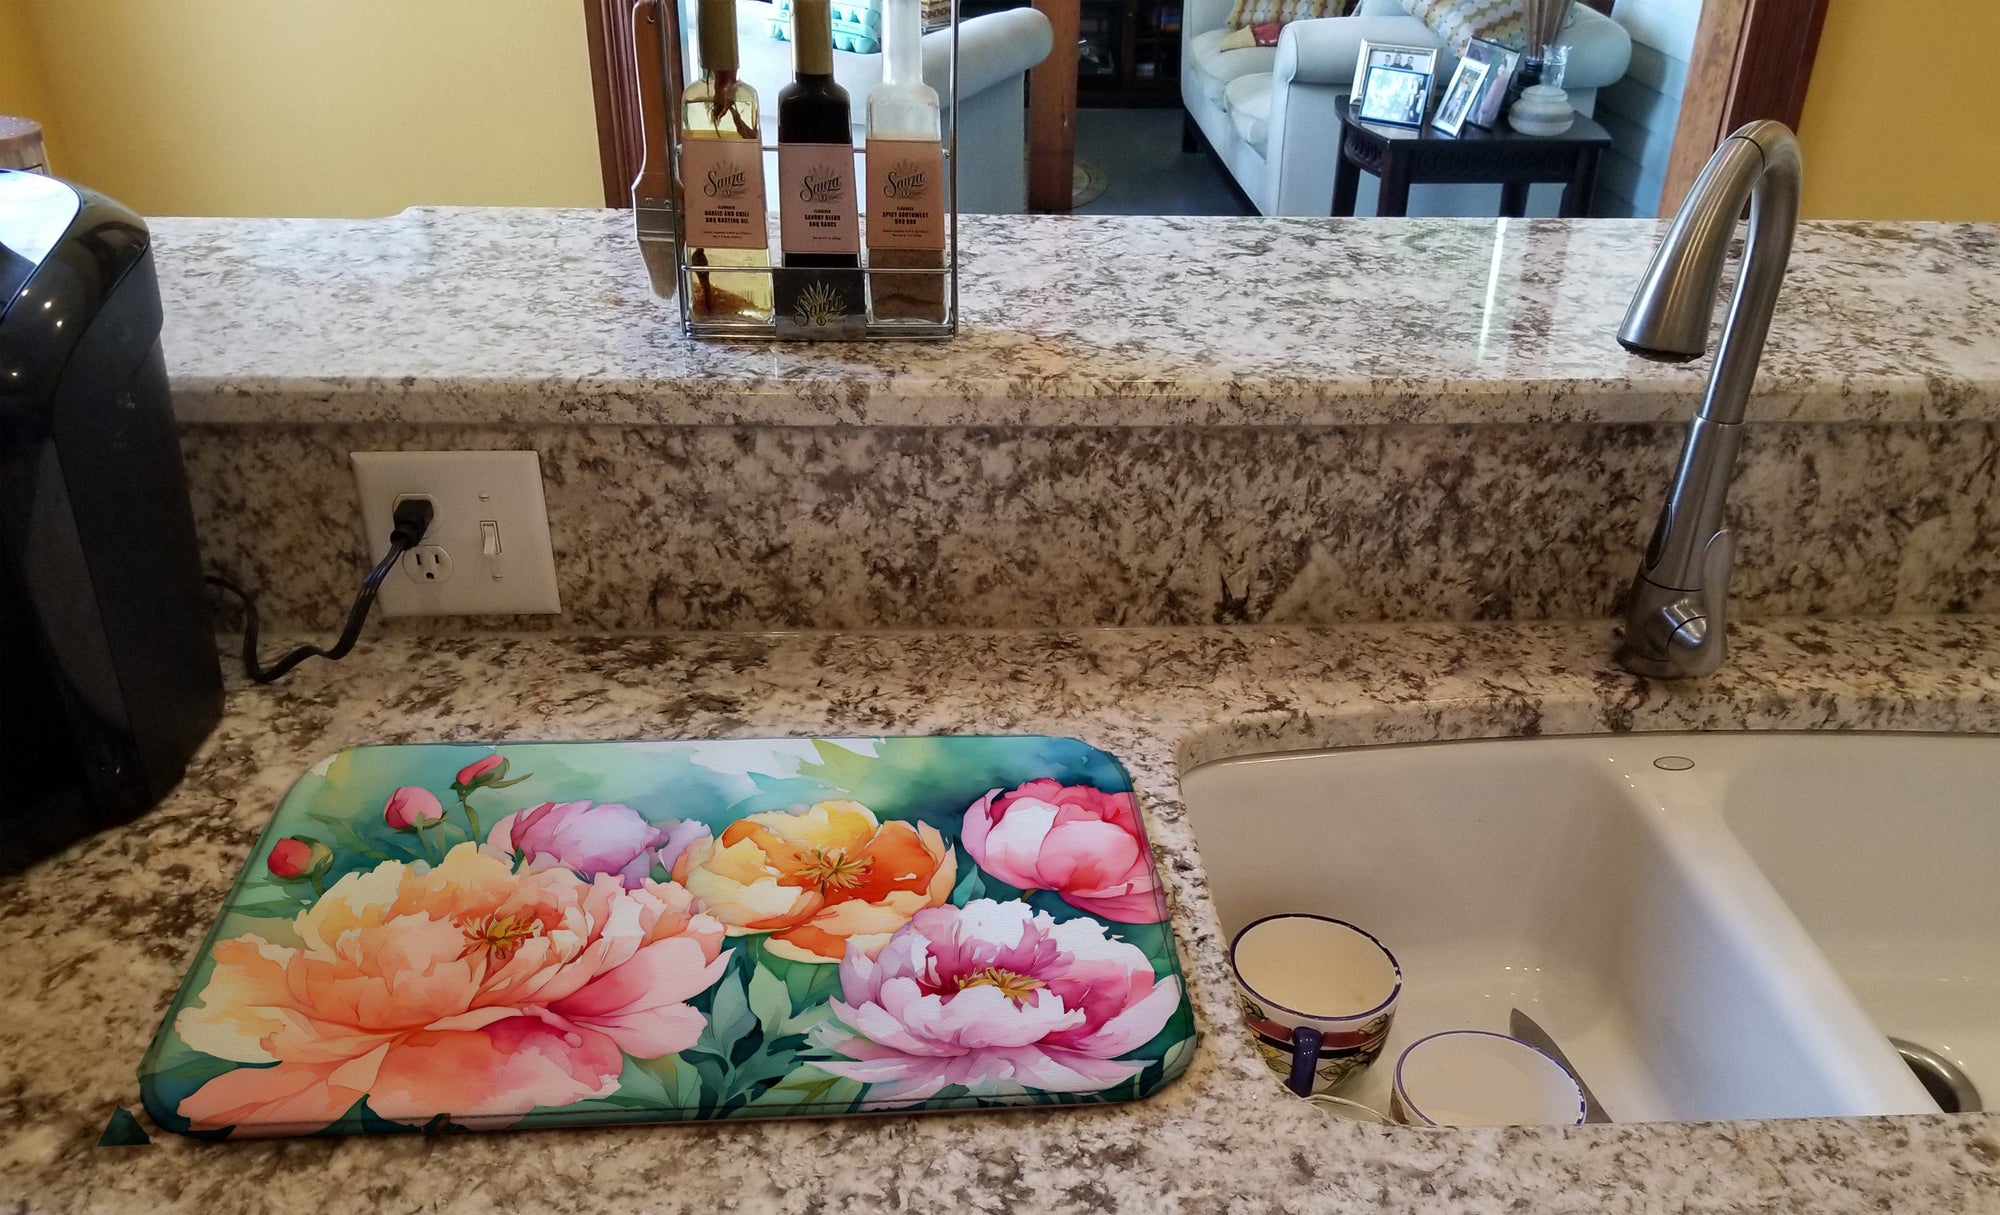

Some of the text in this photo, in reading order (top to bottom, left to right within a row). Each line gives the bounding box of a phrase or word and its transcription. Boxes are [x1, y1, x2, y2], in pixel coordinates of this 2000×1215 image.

[704, 170, 746, 197] Sauza
[800, 175, 842, 202] Sauza
[884, 171, 926, 198] Sauza
